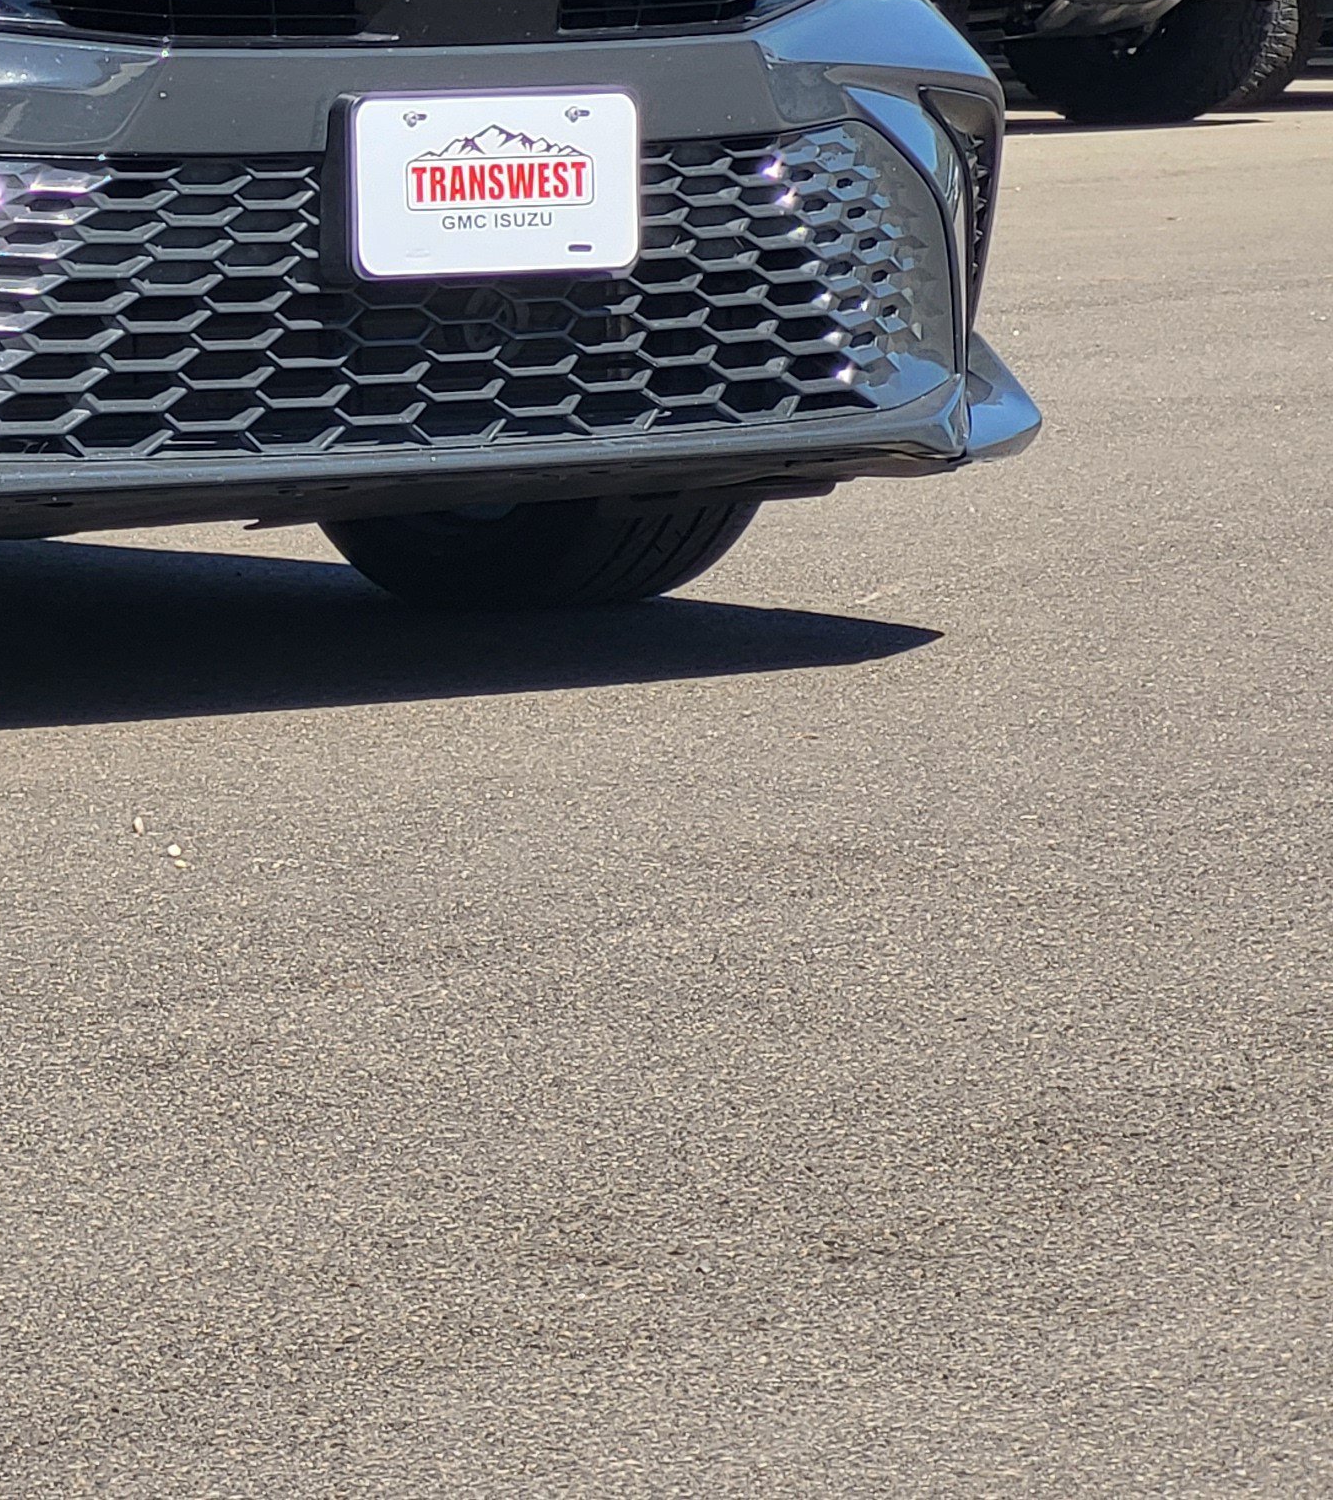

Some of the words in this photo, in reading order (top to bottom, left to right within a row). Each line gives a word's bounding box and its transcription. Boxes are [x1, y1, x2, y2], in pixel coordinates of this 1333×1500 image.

[411, 161, 587, 204] TRANSWEST
[441, 215, 487, 230] GMC
[494, 211, 553, 228] ISUZU
